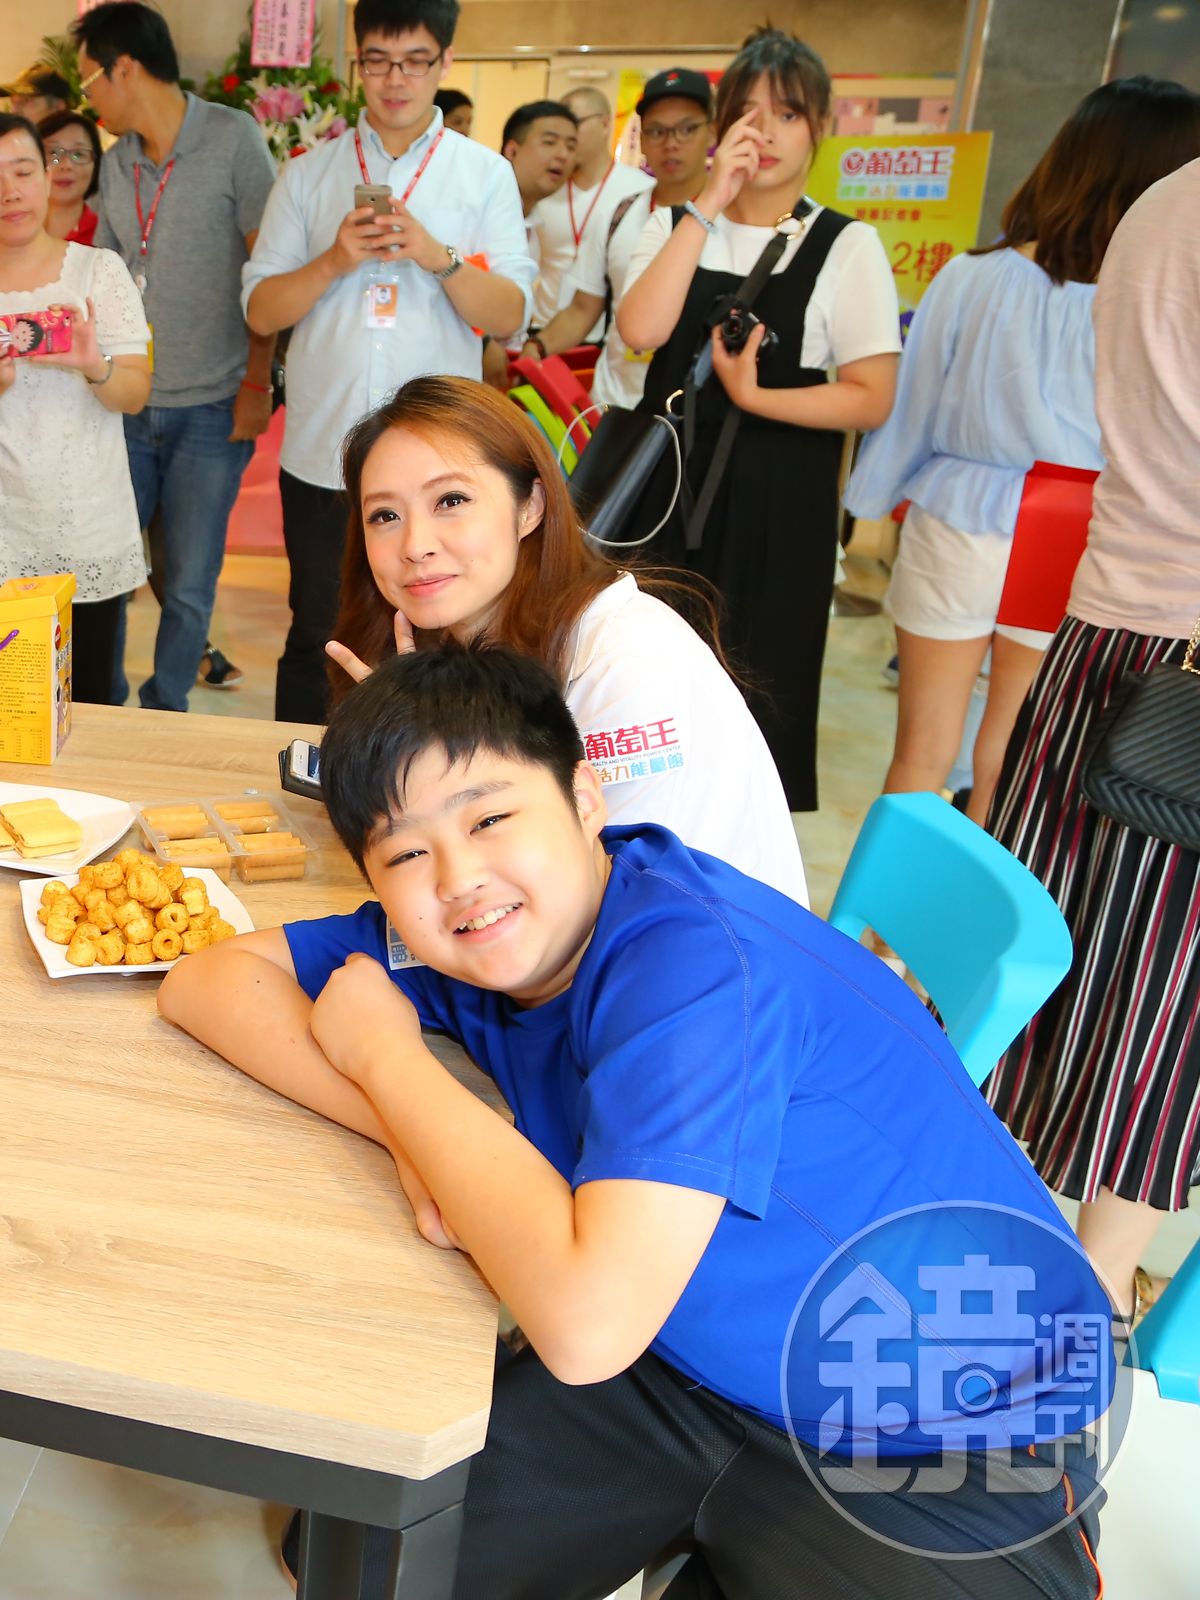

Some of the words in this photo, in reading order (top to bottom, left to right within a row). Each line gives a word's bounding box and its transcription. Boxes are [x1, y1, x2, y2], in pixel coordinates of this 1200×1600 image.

[866, 151, 948, 175] 葡萄王
[584, 717, 679, 761] 葡萄王
[595, 752, 684, 783] 活力能館
